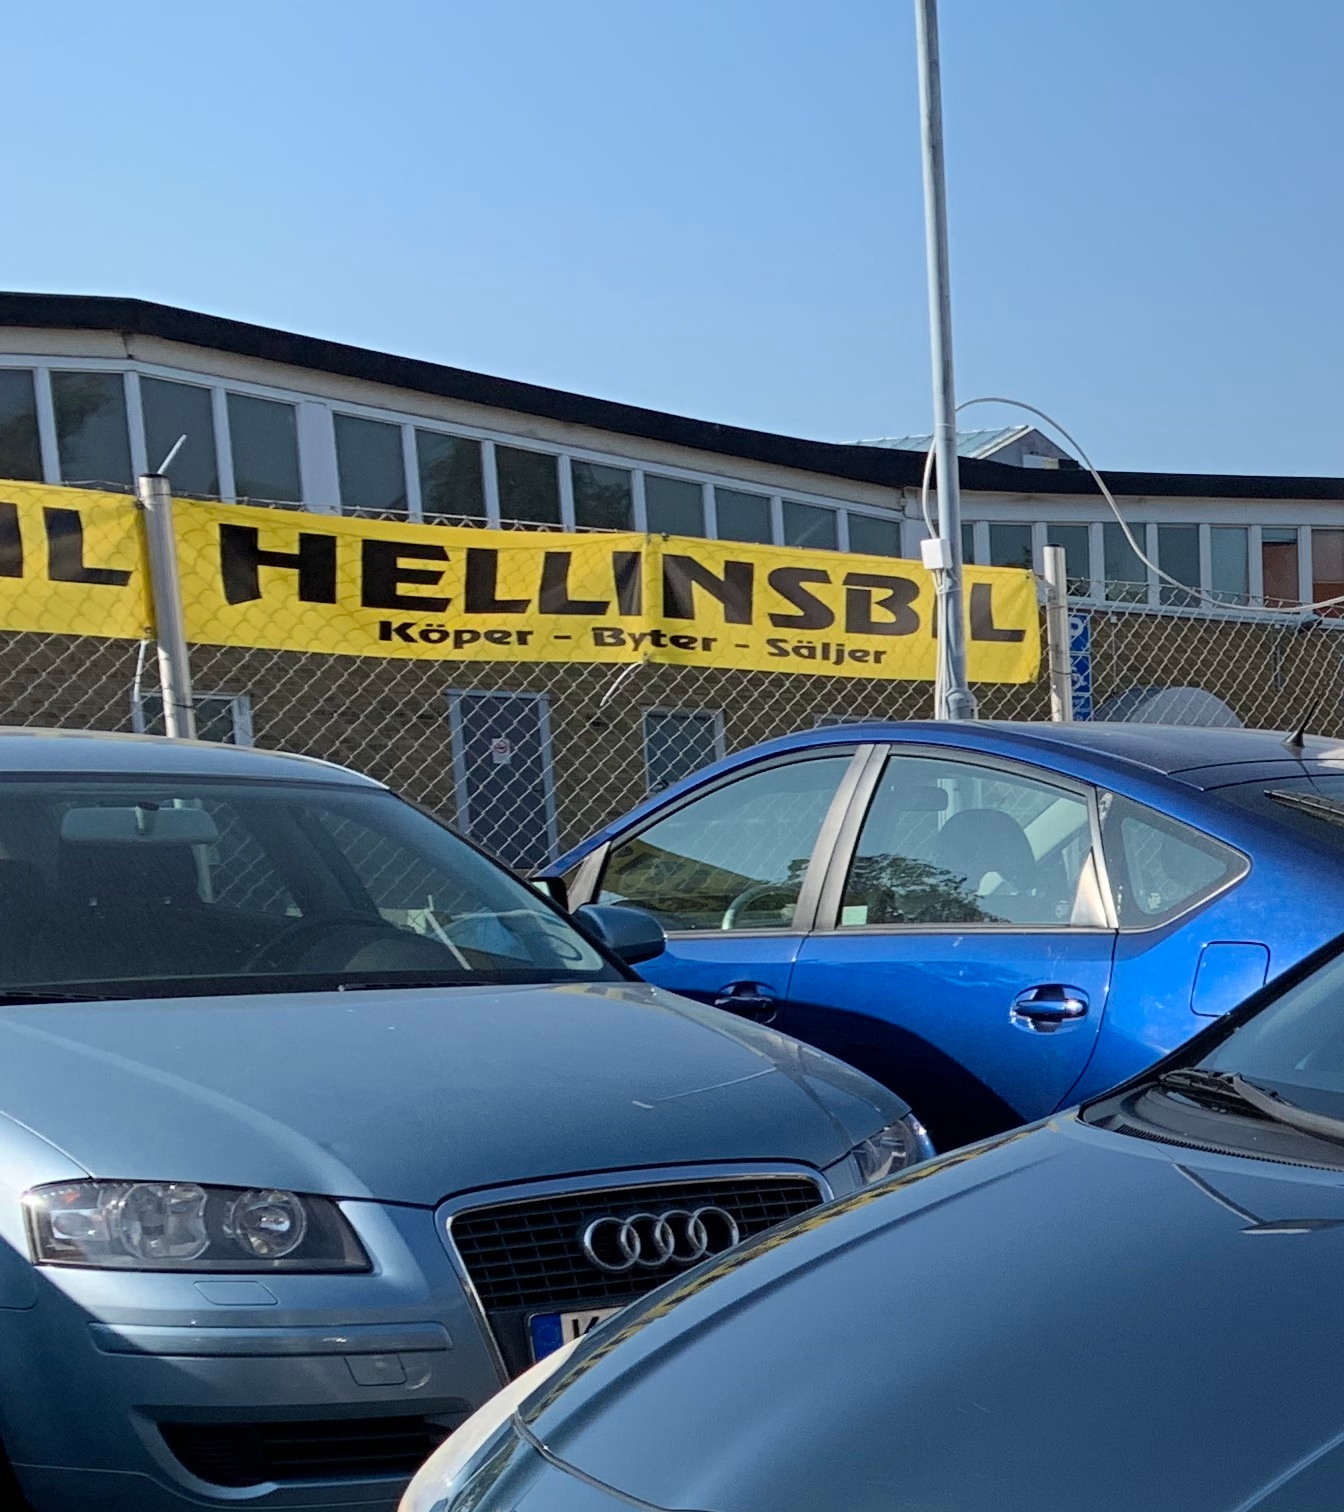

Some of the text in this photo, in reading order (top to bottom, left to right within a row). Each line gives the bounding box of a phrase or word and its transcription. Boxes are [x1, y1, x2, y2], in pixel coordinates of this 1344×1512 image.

[218, 522, 1028, 643] HELLINSBL
[377, 619, 535, 649] Köper
[592, 627, 718, 653] Byter
[766, 638, 888, 666] Säljer
